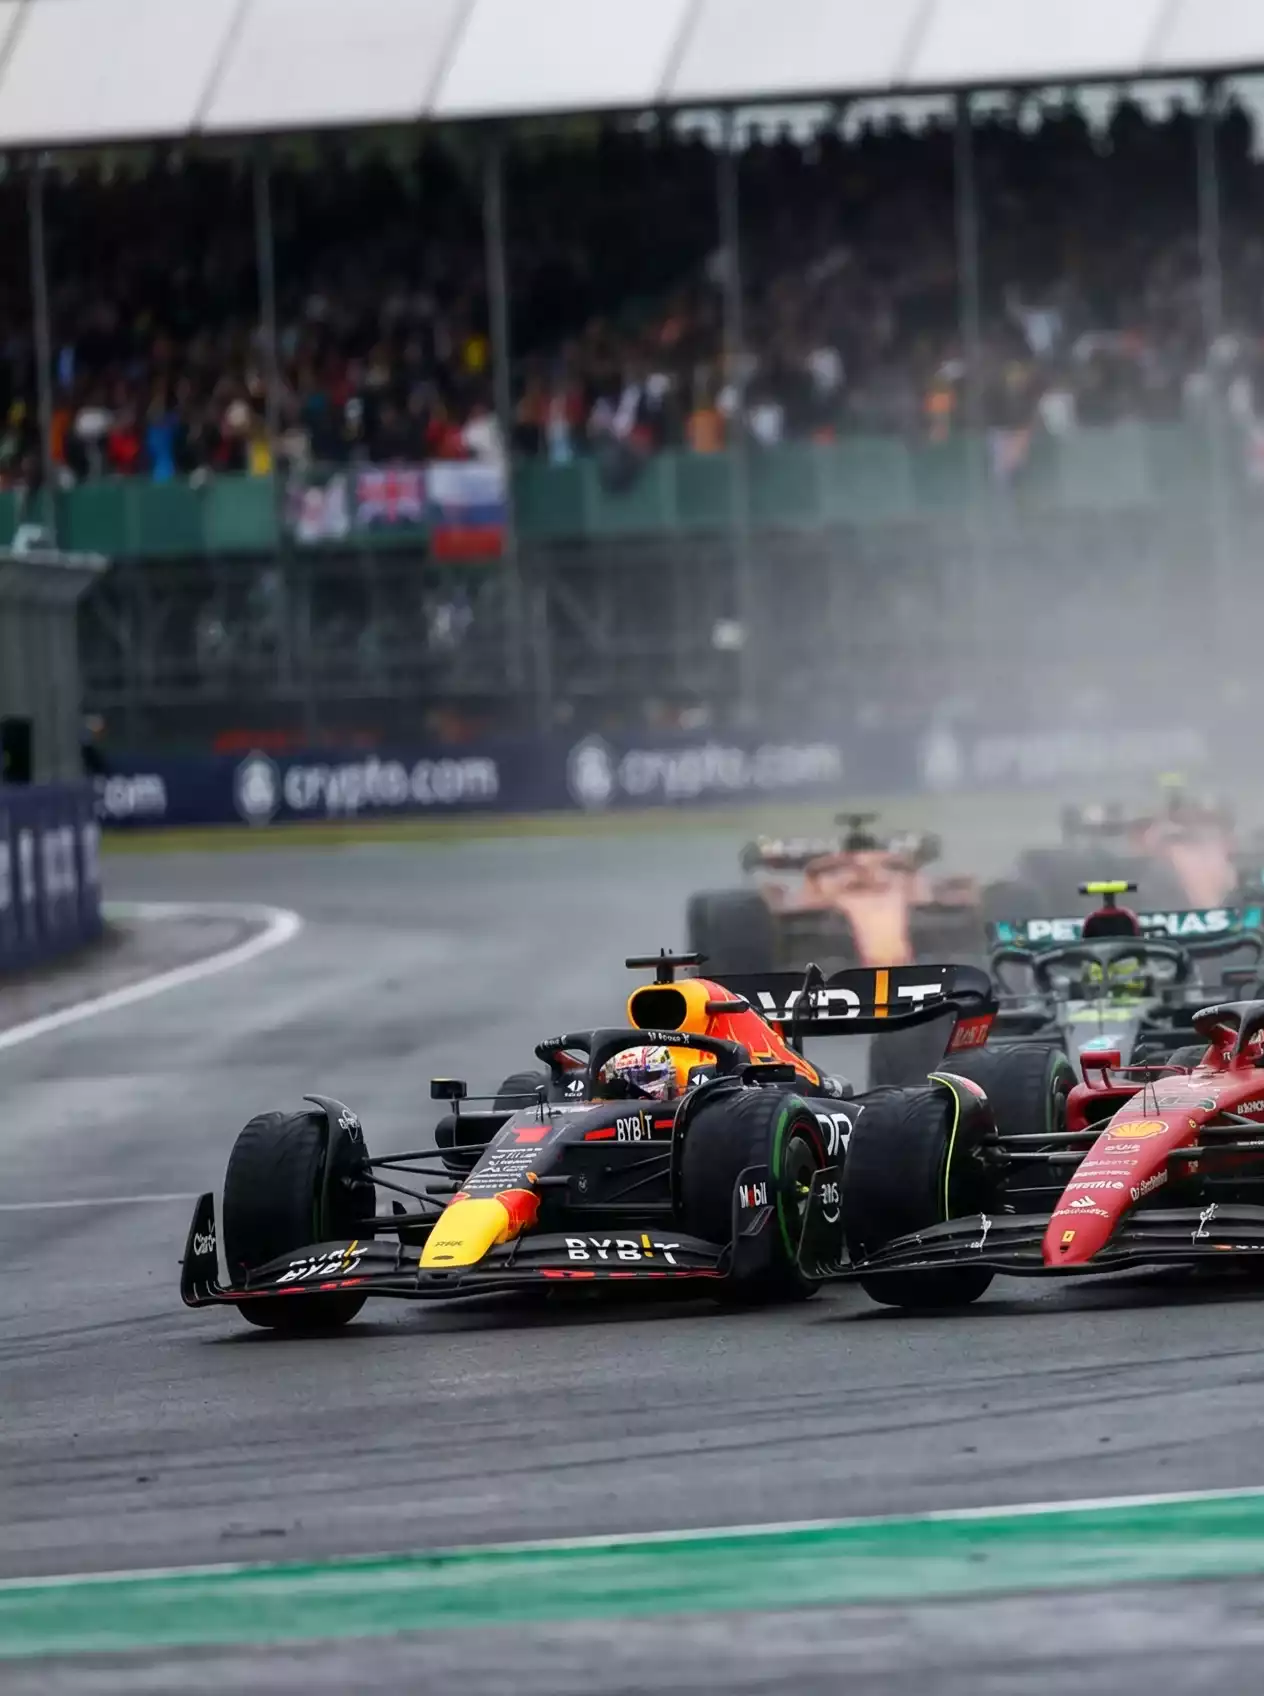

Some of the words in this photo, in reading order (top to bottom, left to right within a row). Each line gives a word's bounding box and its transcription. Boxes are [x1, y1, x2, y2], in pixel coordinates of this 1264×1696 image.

[282, 756, 500, 819] crypto.com
[615, 1109, 653, 1142] BYBIT
[565, 1234, 680, 1264] BYBIT
